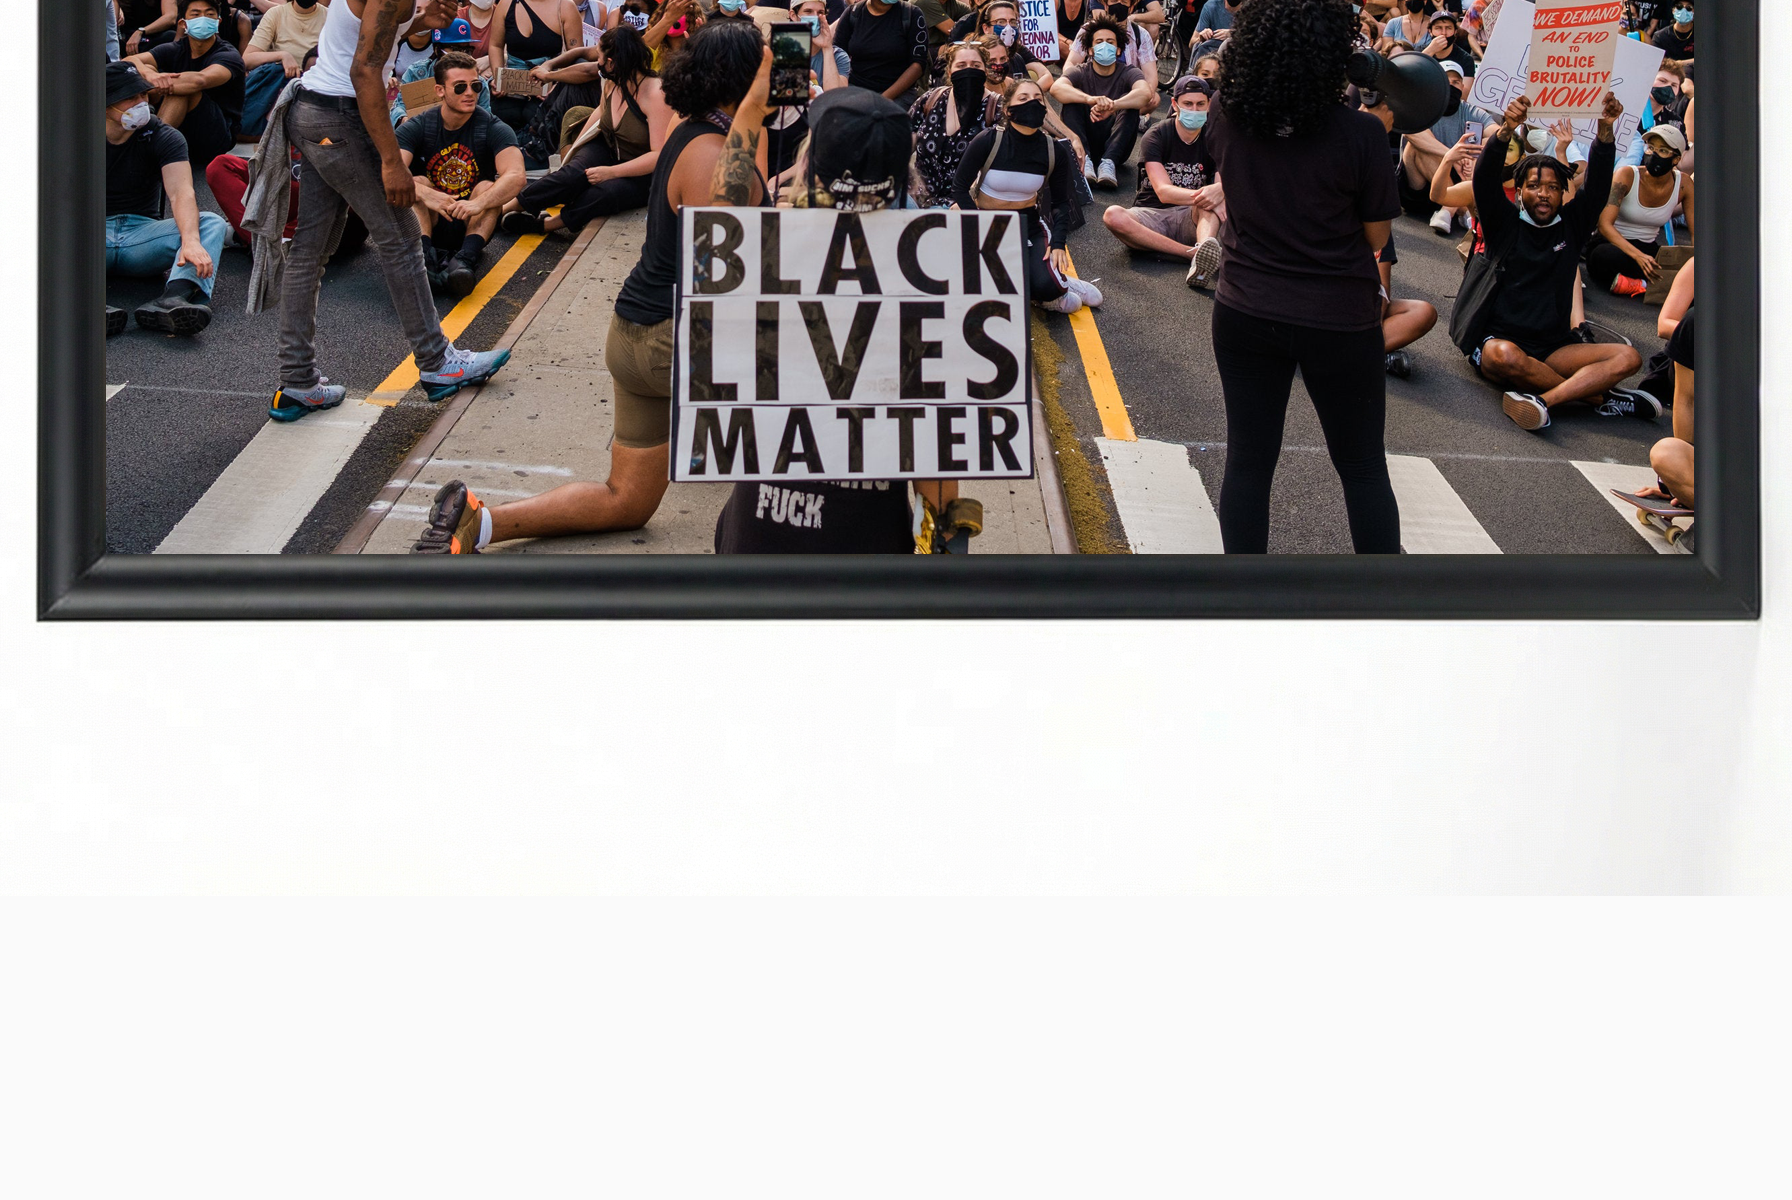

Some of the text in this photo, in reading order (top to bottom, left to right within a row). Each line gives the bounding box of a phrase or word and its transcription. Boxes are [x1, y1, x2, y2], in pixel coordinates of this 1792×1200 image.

[1019, 0, 1051, 18] STICE
[1534, 5, 1620, 27] WE DEMAND
[1023, 18, 1039, 31] FOR
[1020, 31, 1055, 45] EONNA
[1542, 31, 1609, 44] AN END
[1569, 45, 1580, 53] TO
[1546, 55, 1596, 68] POLICE
[501, 70, 524, 80] BLACK
[1530, 71, 1611, 84] BRUTALITY
[1533, 86, 1602, 108] NOW!
[691, 211, 1018, 295] BLACK
[688, 300, 1020, 402] LIVES
[688, 406, 1022, 476] MATTER
[756, 483, 825, 529] FUCK
